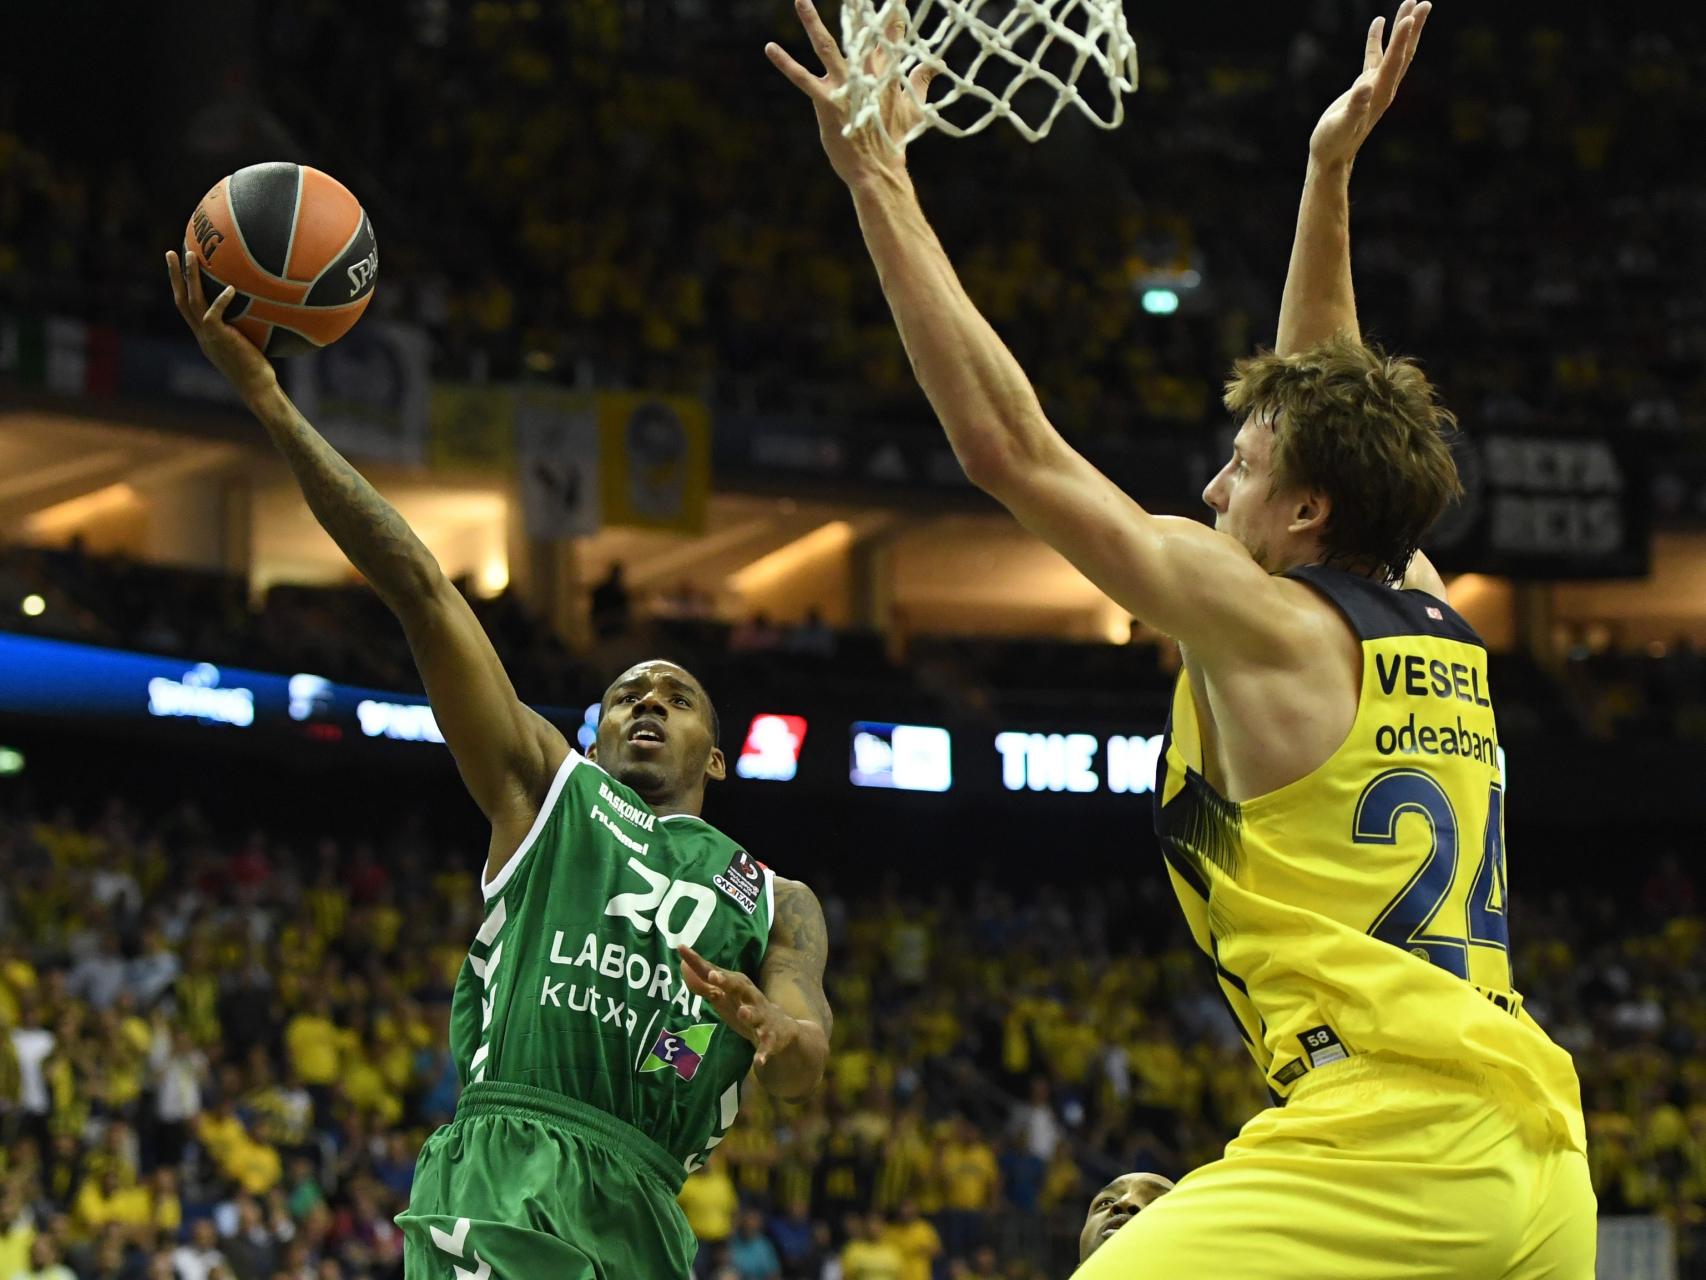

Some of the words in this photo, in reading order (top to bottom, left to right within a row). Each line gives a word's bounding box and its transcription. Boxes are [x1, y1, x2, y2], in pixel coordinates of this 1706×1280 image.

[1376, 653, 1490, 708] VESEL
[995, 731, 1098, 792] THE
[599, 782, 657, 832] BASKONIA
[732, 889, 755, 912] TEAM
[1352, 767, 1508, 982] 24
[604, 857, 717, 949] 20
[1307, 1030, 1330, 1047] 58
